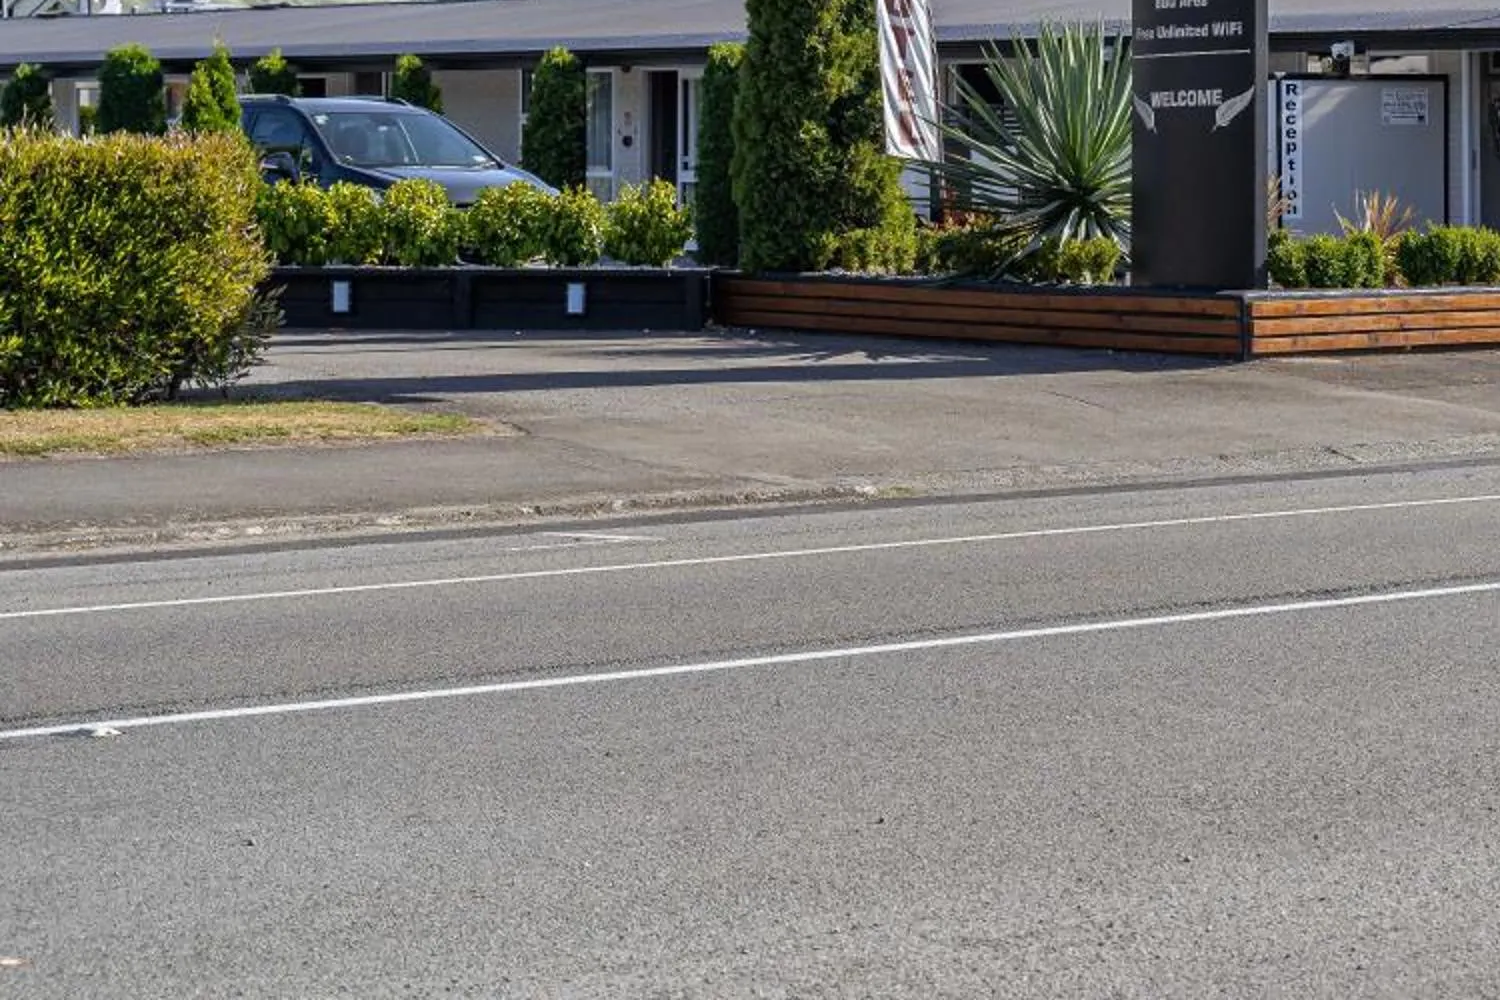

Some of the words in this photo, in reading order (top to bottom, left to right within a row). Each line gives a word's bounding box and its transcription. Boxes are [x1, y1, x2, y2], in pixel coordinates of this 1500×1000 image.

[1156, 23, 1209, 39] Unlimited
[1151, 89, 1223, 108] WELCOME
[1285, 83, 1297, 215] Reception
